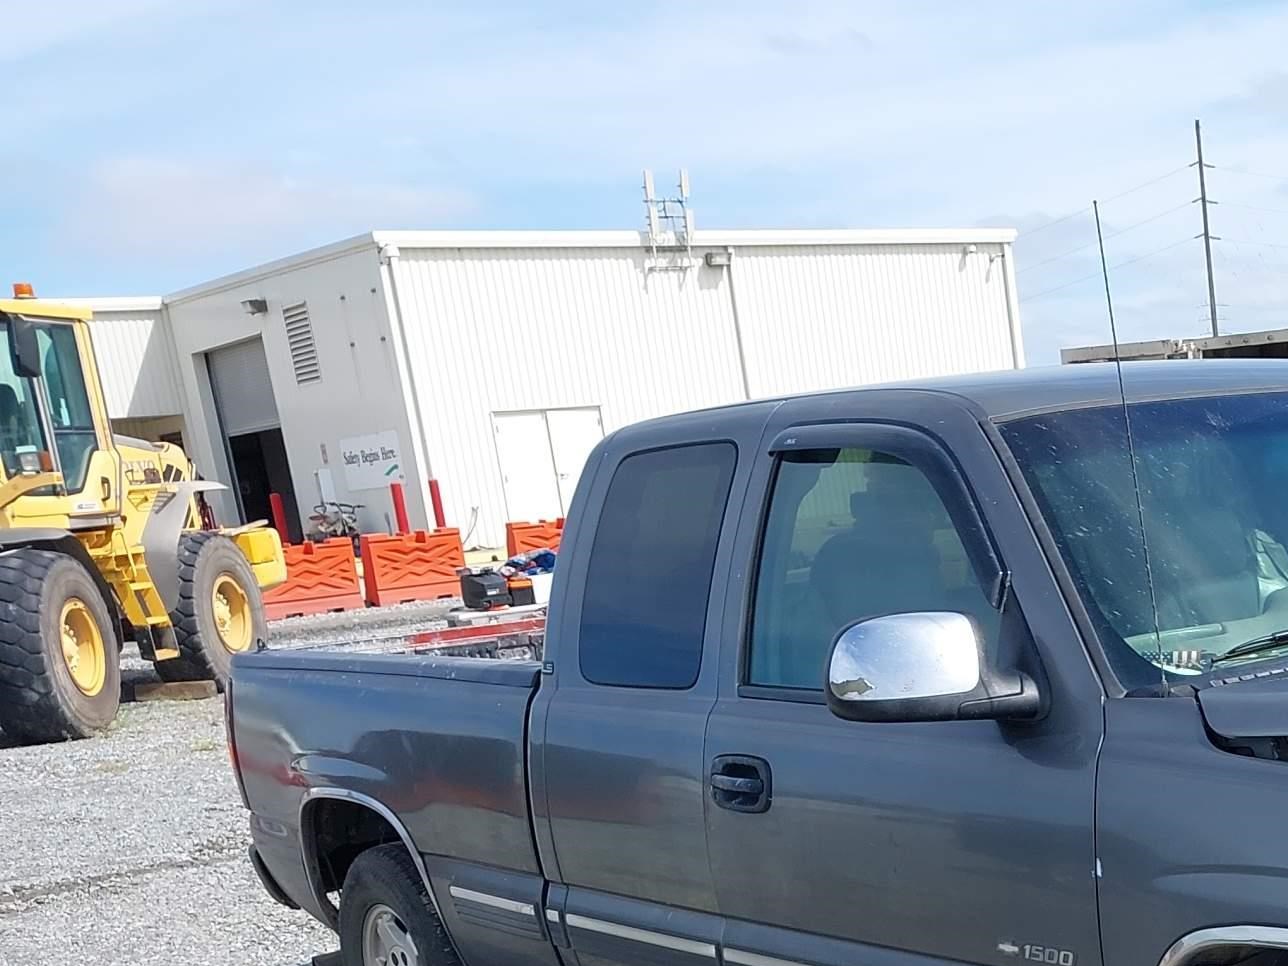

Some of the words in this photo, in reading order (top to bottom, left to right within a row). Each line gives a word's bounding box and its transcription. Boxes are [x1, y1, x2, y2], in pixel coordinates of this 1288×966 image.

[343, 450, 361, 467] Safety
[361, 447, 380, 466] Begins
[381, 446, 396, 461] Here
[1023, 944, 1074, 966] 1500
